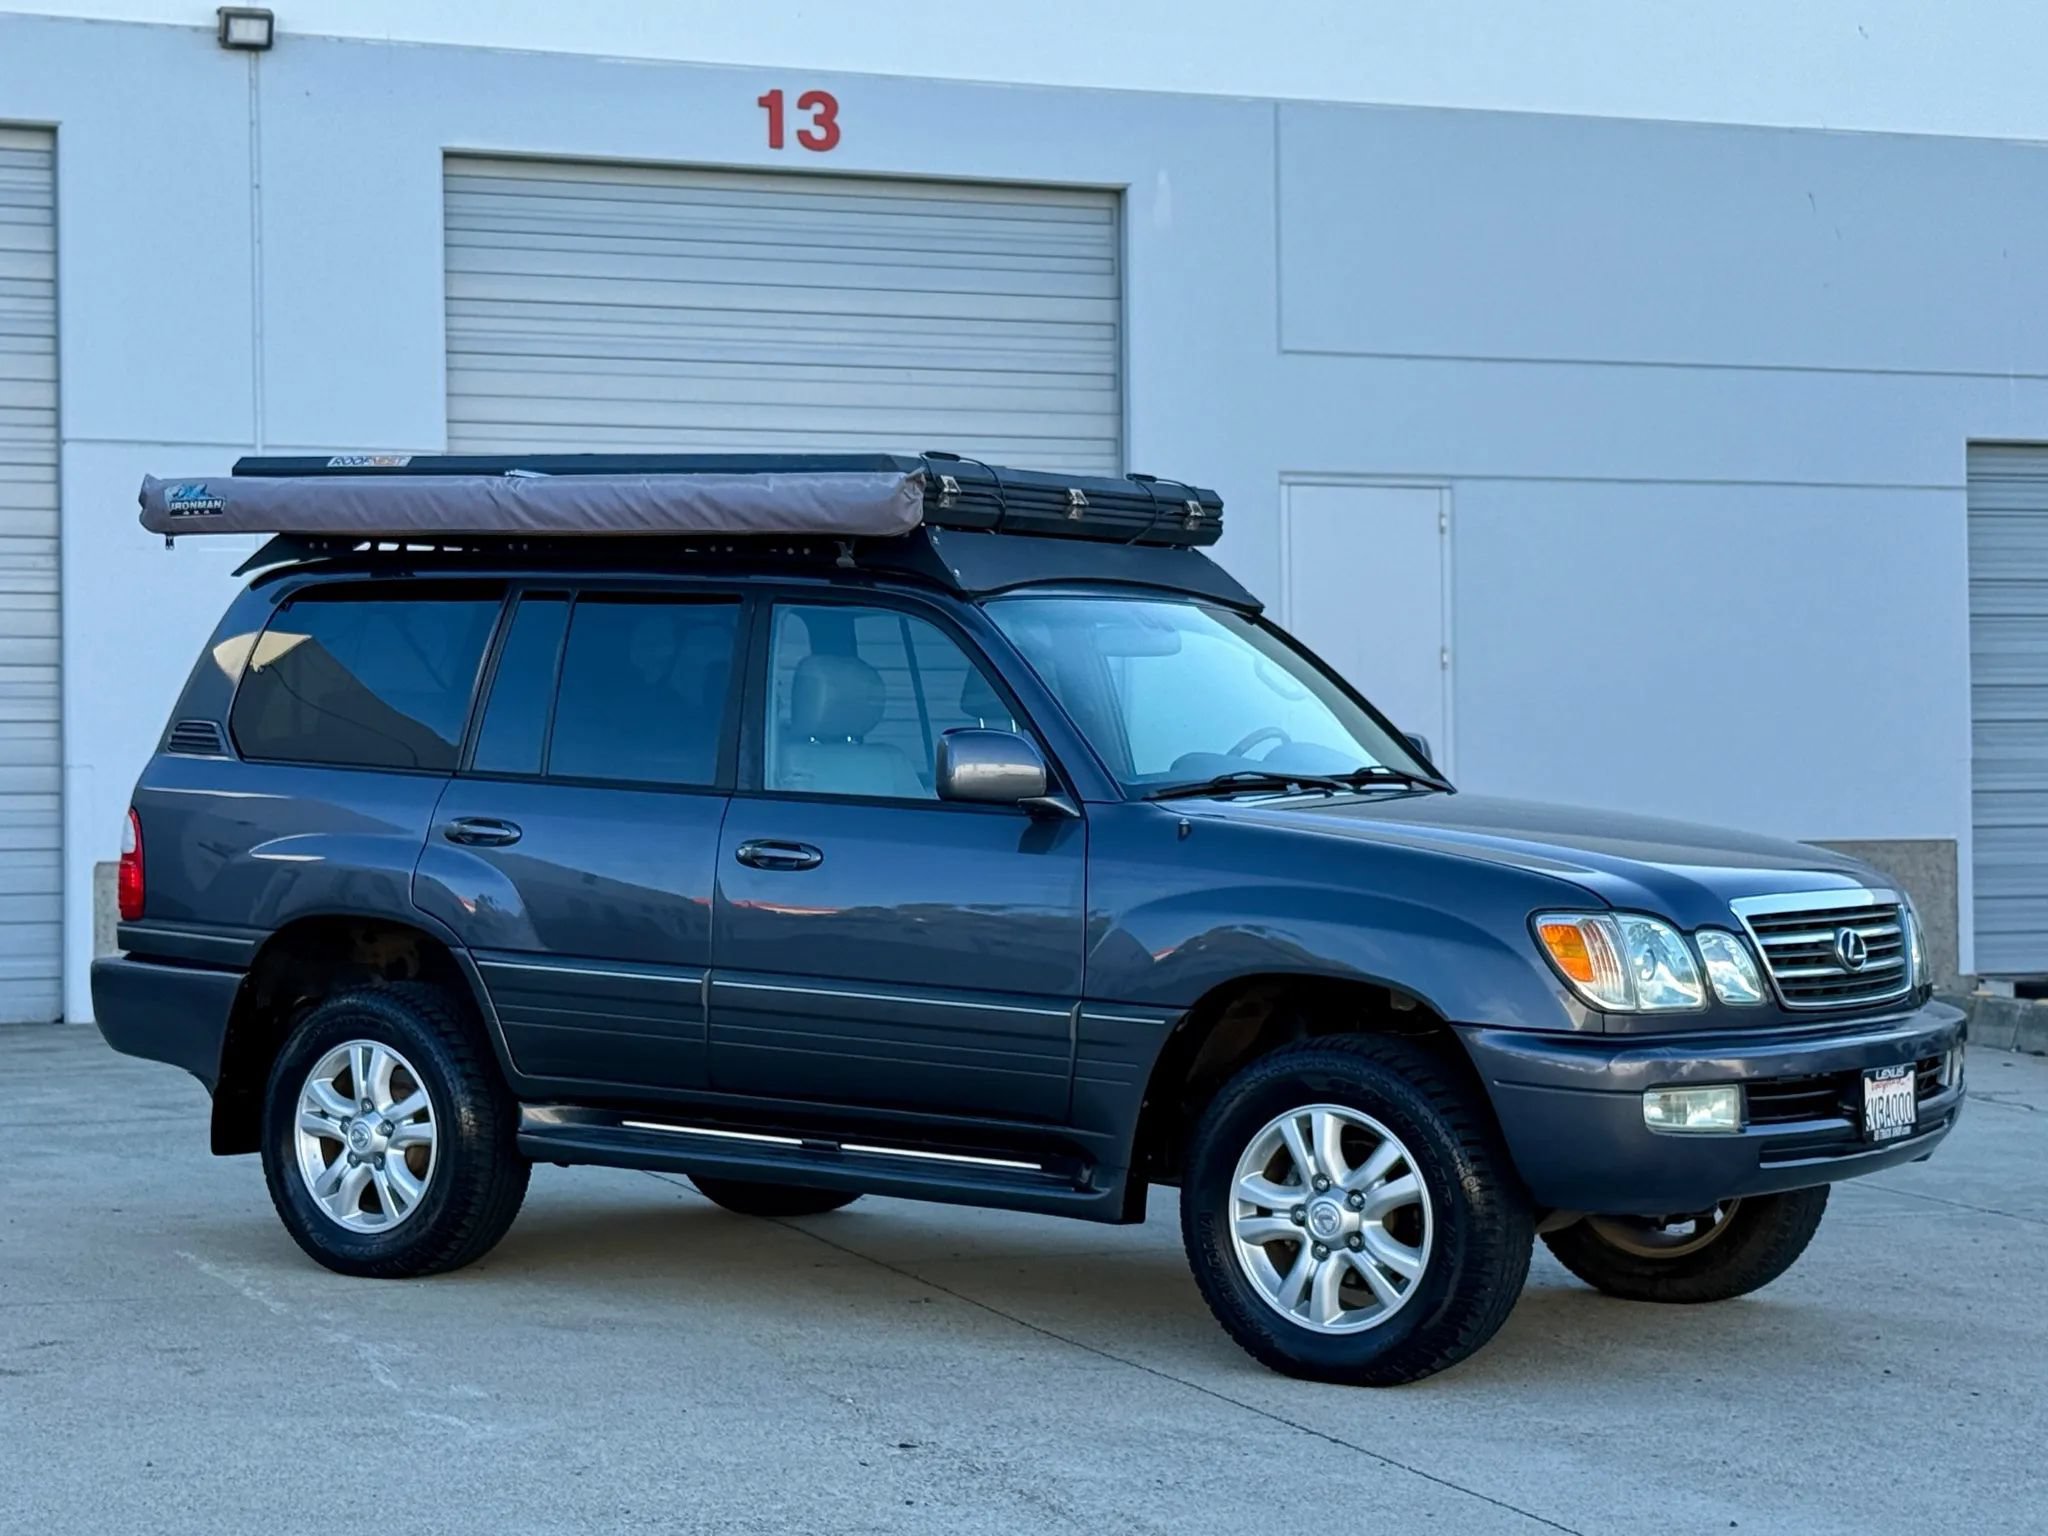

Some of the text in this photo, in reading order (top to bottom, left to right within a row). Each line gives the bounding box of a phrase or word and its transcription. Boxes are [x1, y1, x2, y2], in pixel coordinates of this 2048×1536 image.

[758, 89, 840, 152] 13
[171, 500, 222, 511] IRONMAN
[1875, 1066, 1904, 1080] LEXUS
